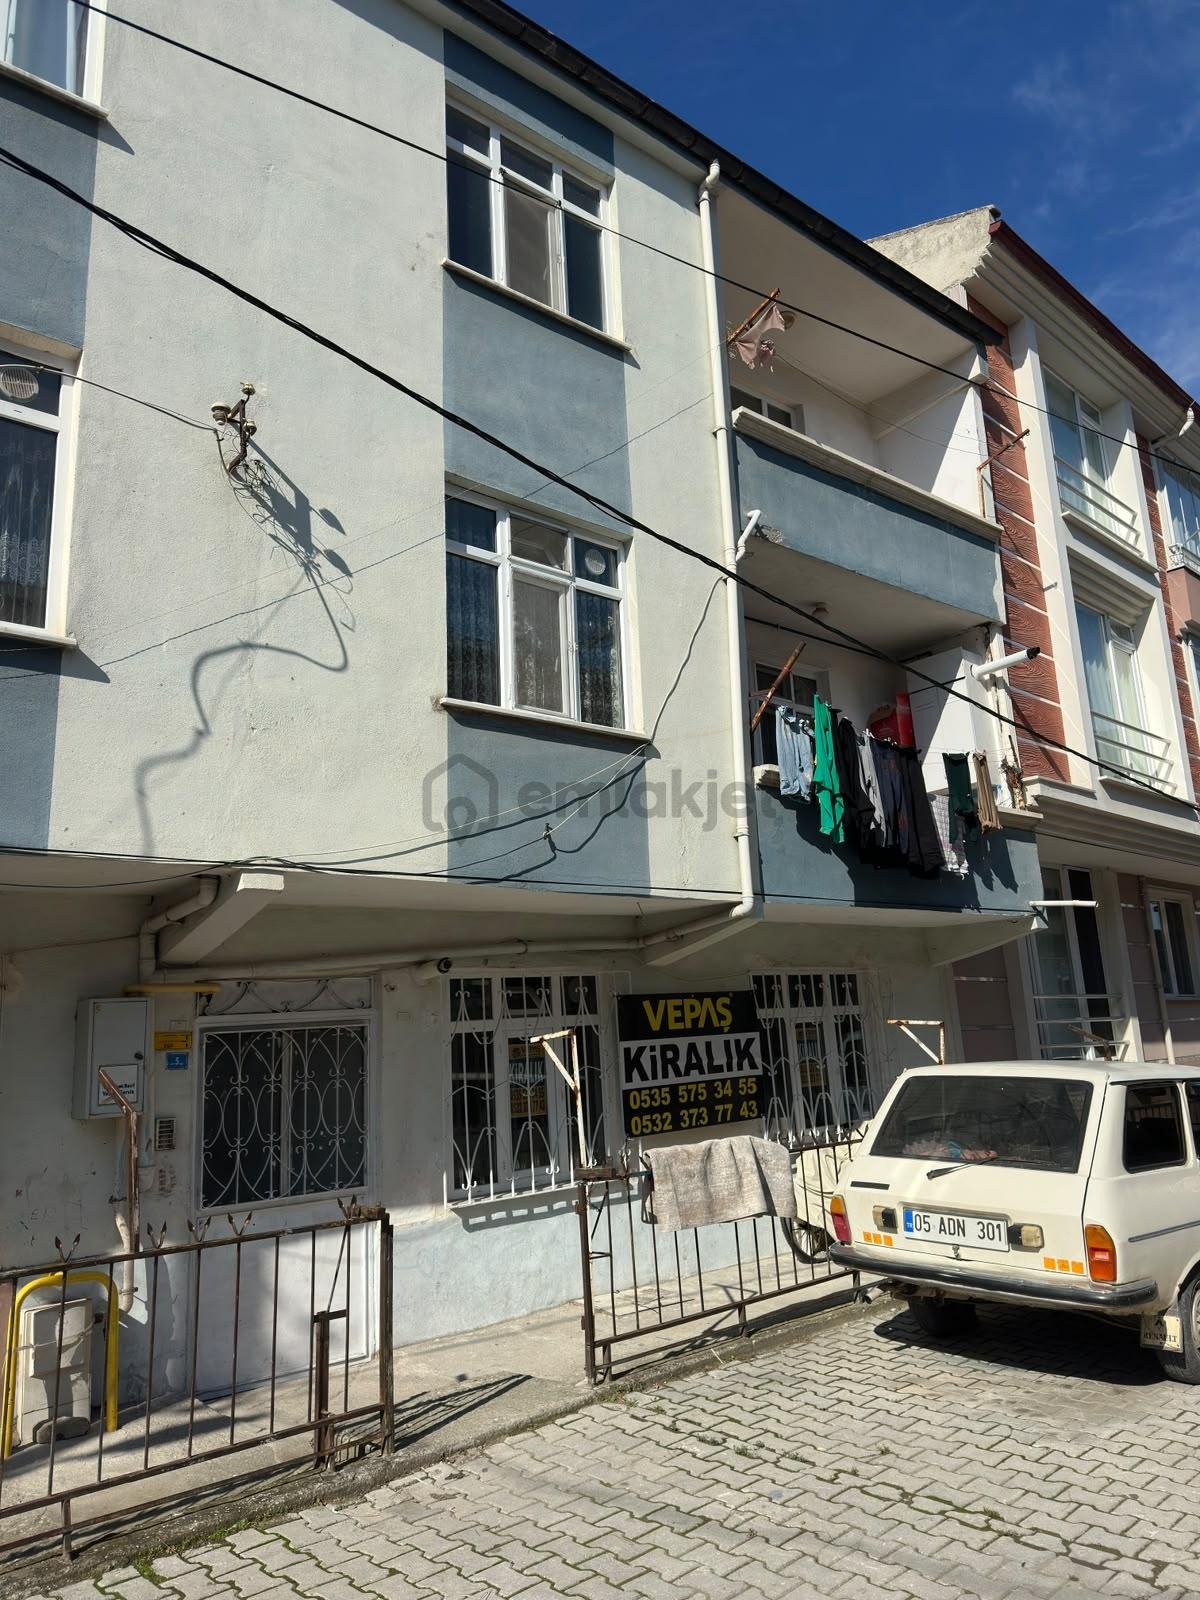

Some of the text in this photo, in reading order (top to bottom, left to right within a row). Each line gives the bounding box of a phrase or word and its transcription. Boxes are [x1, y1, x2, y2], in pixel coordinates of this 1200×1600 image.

[642, 996, 733, 1033] VEPAŞ
[629, 1077, 758, 1110] 0535 575 34 55
[630, 1100, 758, 1135] 0532 373 77 43
[914, 1213, 931, 1233] 05
[938, 1216, 966, 1237] ADN
[977, 1221, 1002, 1242] 301
